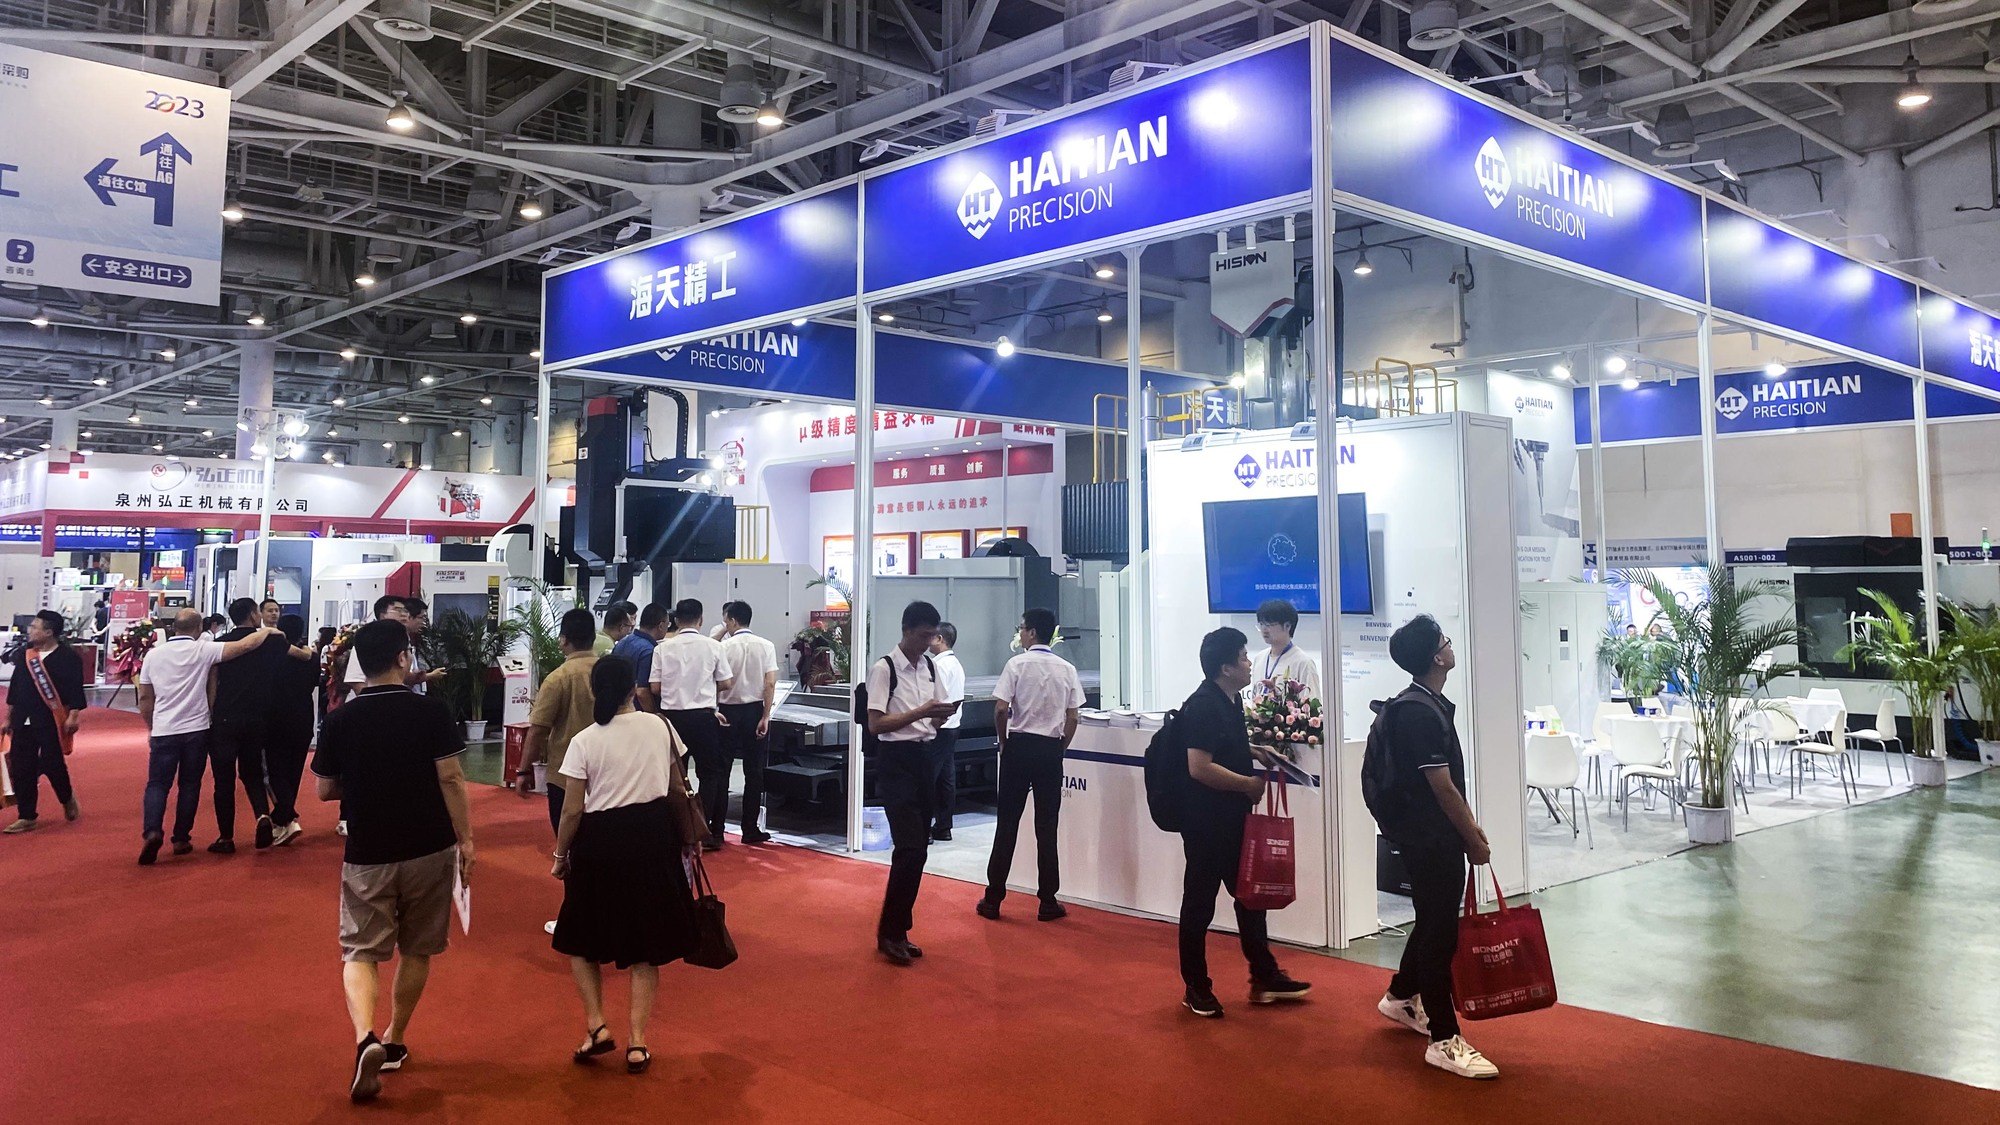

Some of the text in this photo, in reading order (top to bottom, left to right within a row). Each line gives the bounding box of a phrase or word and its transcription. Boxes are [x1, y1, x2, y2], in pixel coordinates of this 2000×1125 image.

[145, 90, 204, 118] 2023
[1009, 115, 1167, 198] HAITIAN
[1481, 154, 1505, 185] HT
[1515, 146, 1614, 217] HAITIAN
[964, 188, 995, 217] HT
[1009, 182, 1113, 232] PRECISION
[1517, 195, 1586, 240] PRECISION
[6, 265, 35, 277] 咨询台
[104, 259, 172, 282] 安全出口
[629, 250, 737, 320] 海天精工
[697, 329, 798, 357] AITIAN
[690, 350, 765, 374] PRECISION
[1720, 396, 1742, 408] HT
[1752, 374, 1861, 402] HAITIAN
[1753, 401, 1826, 418] PRECISION
[929, 464, 946, 476] 质量
[1237, 462, 1258, 477] HT
[1265, 444, 1356, 470] HAITN
[1265, 472, 1318, 488] PRECISIO
